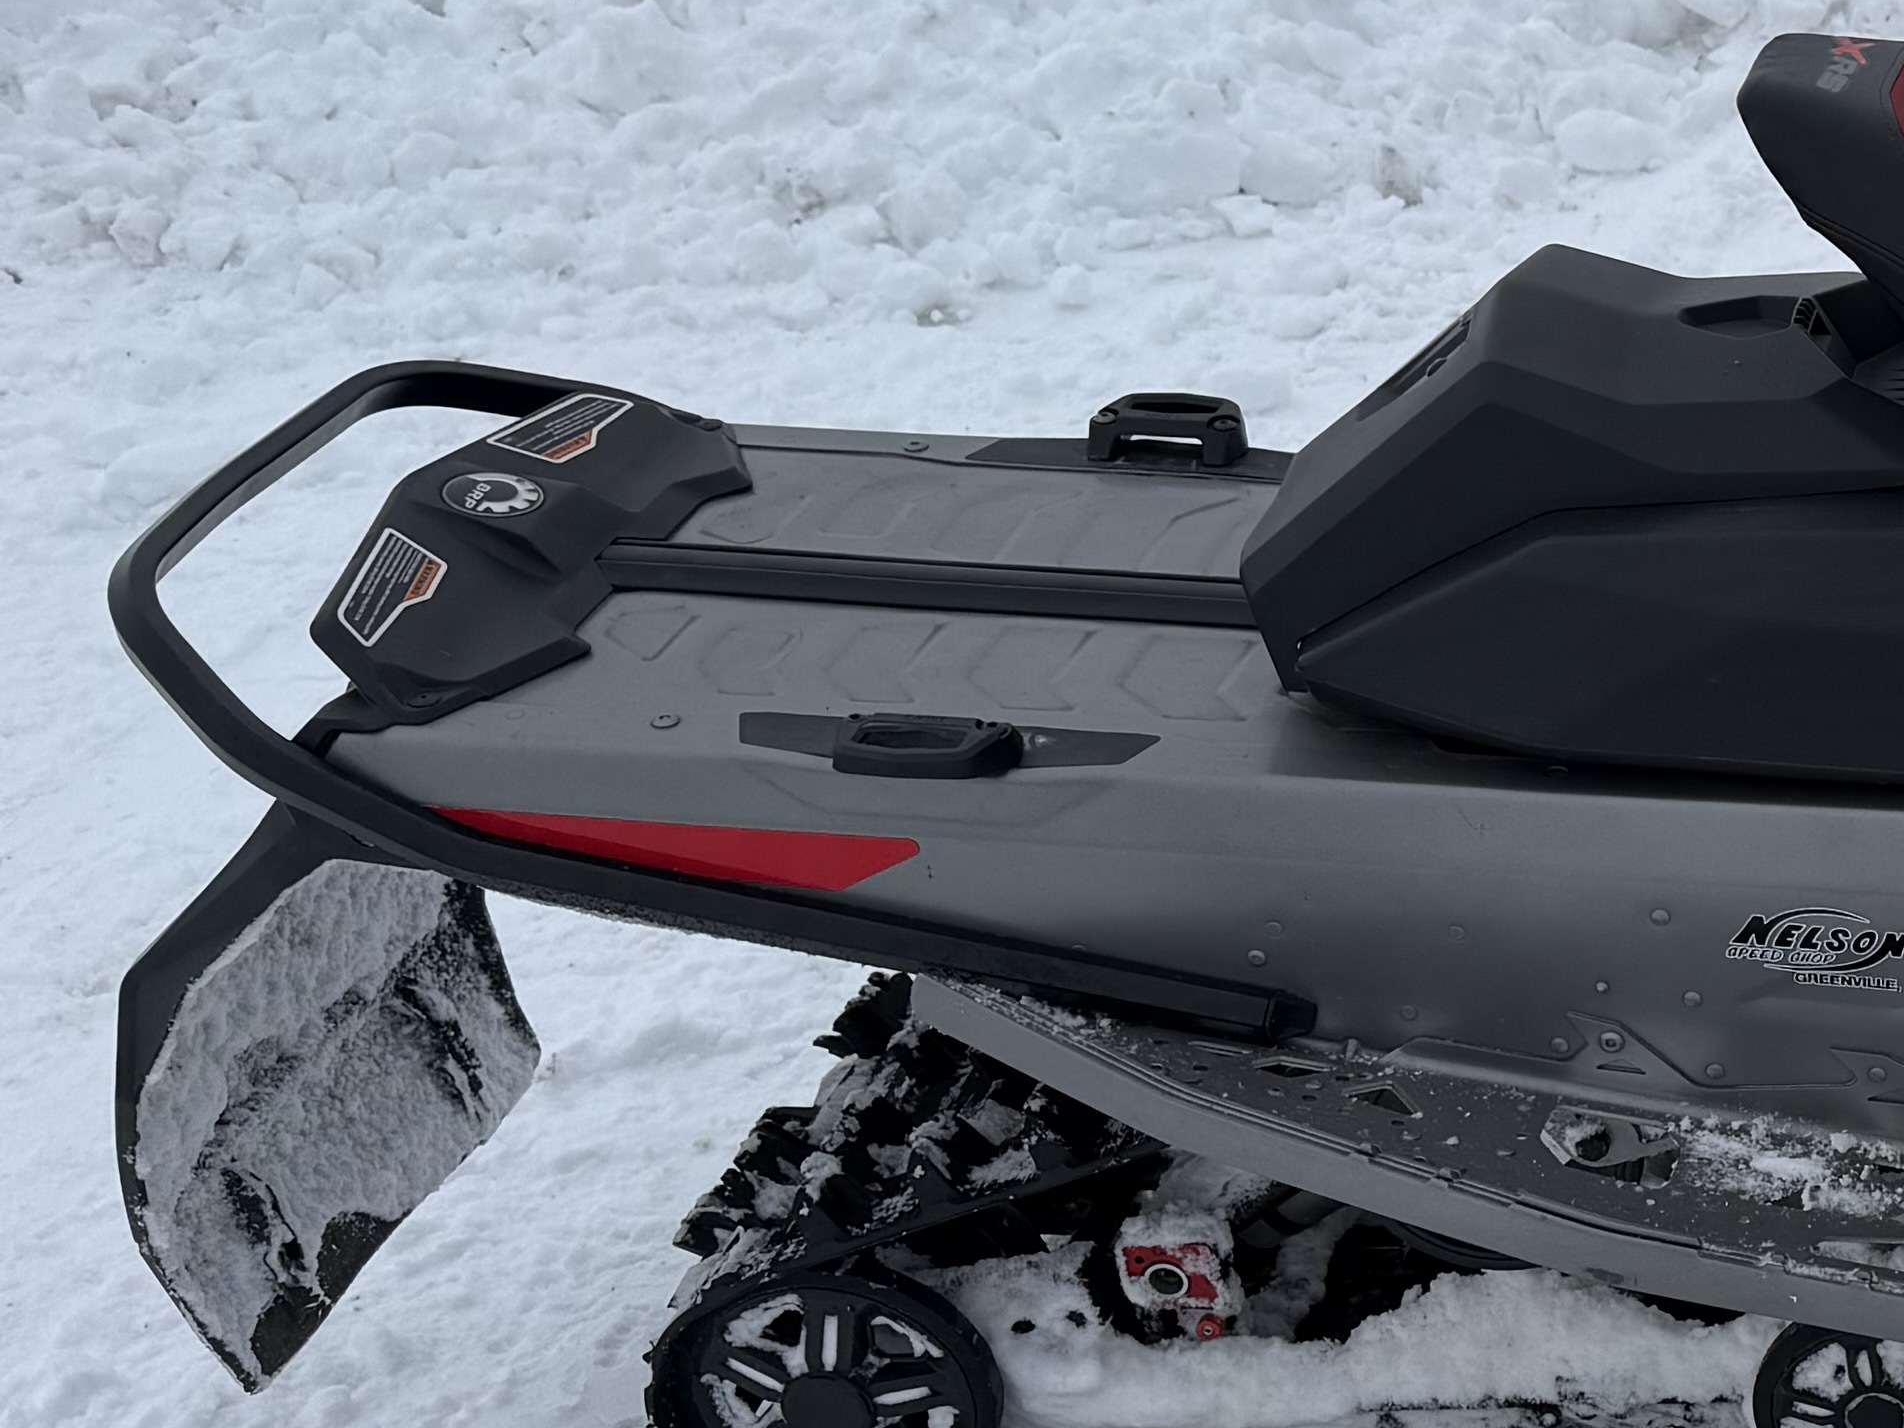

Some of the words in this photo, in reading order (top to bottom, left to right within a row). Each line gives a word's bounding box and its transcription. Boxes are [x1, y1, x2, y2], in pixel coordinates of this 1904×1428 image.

[464, 482, 492, 509] BRP
[1726, 945, 1784, 962] SPEED
[1788, 950, 1836, 965] SHOP
